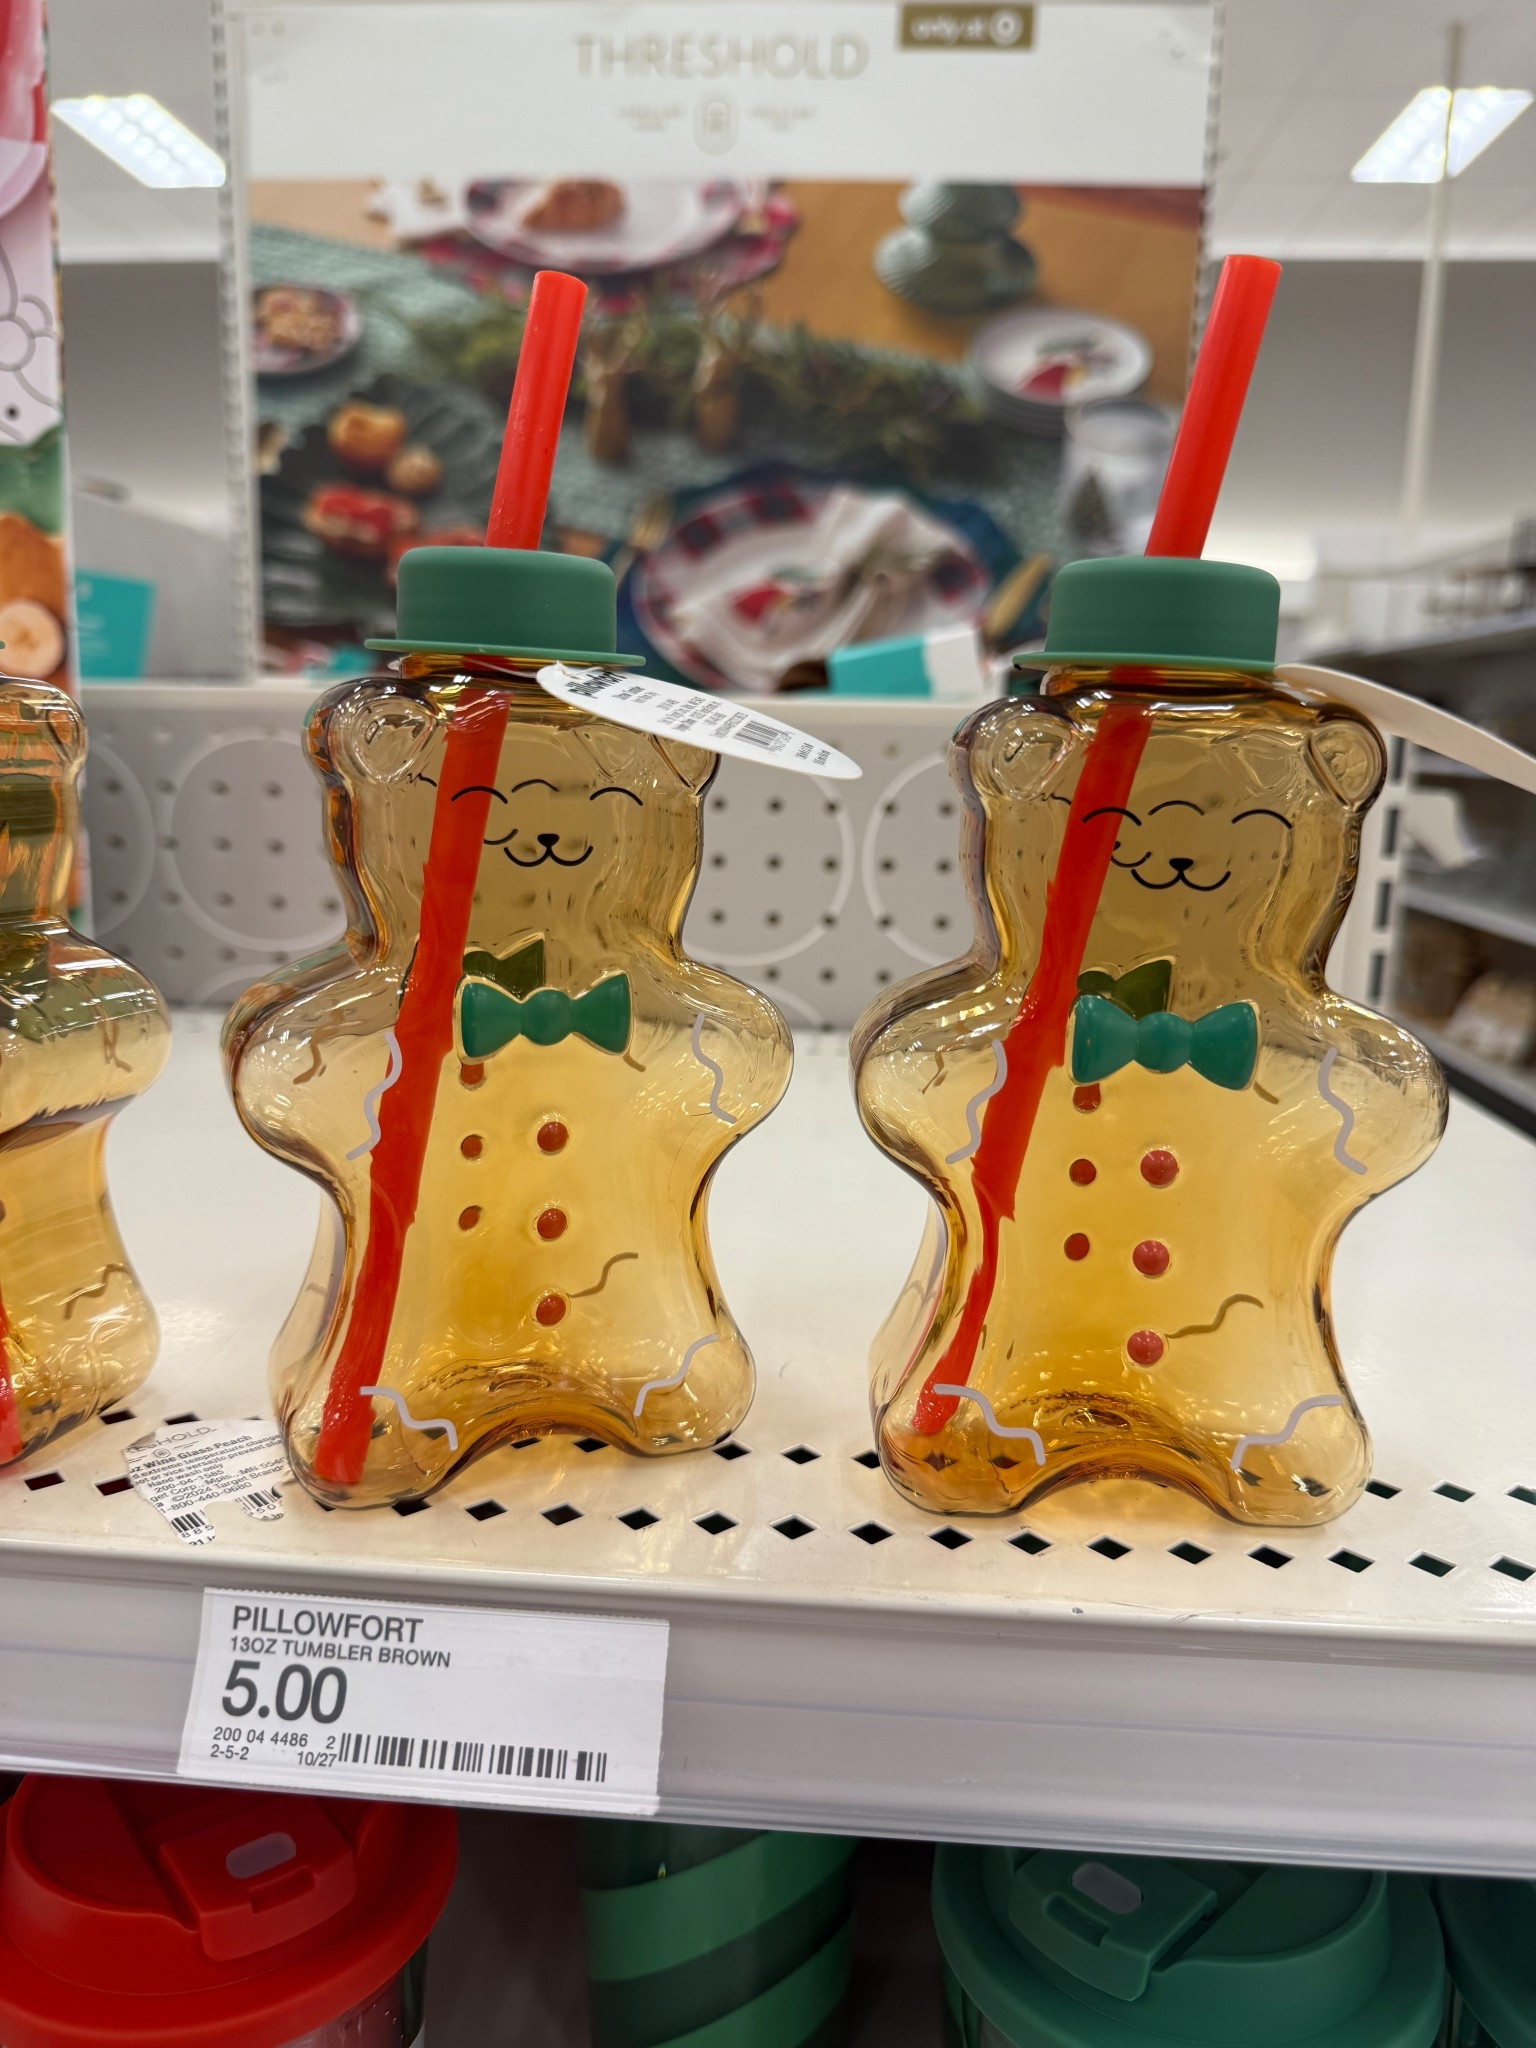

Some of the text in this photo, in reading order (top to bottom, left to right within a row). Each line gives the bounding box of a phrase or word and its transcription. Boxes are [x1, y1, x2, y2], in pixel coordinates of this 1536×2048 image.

[910, 14, 959, 45] only
[573, 32, 870, 81] THRESHOLD
[141, 1462, 184, 1477] extreme
[183, 1445, 245, 1465] temperature
[143, 1456, 177, 1468] Wine
[177, 1446, 214, 1459] Glass
[213, 1435, 253, 1449] Peach
[163, 1467, 185, 1477] vice
[227, 1444, 265, 1459] prevent
[147, 1463, 224, 1488] Hand wash only
[213, 1475, 249, 1489] Target
[239, 1465, 259, 1475] MN
[232, 1605, 424, 1643] PILLOWFORT
[231, 1635, 451, 1668] 13OZ TUMBLER BROWN
[222, 1659, 347, 1724] 5.00
[213, 1726, 337, 1750] 200 04 4486 2
[210, 1744, 338, 1768] 2-5-2 10/27
